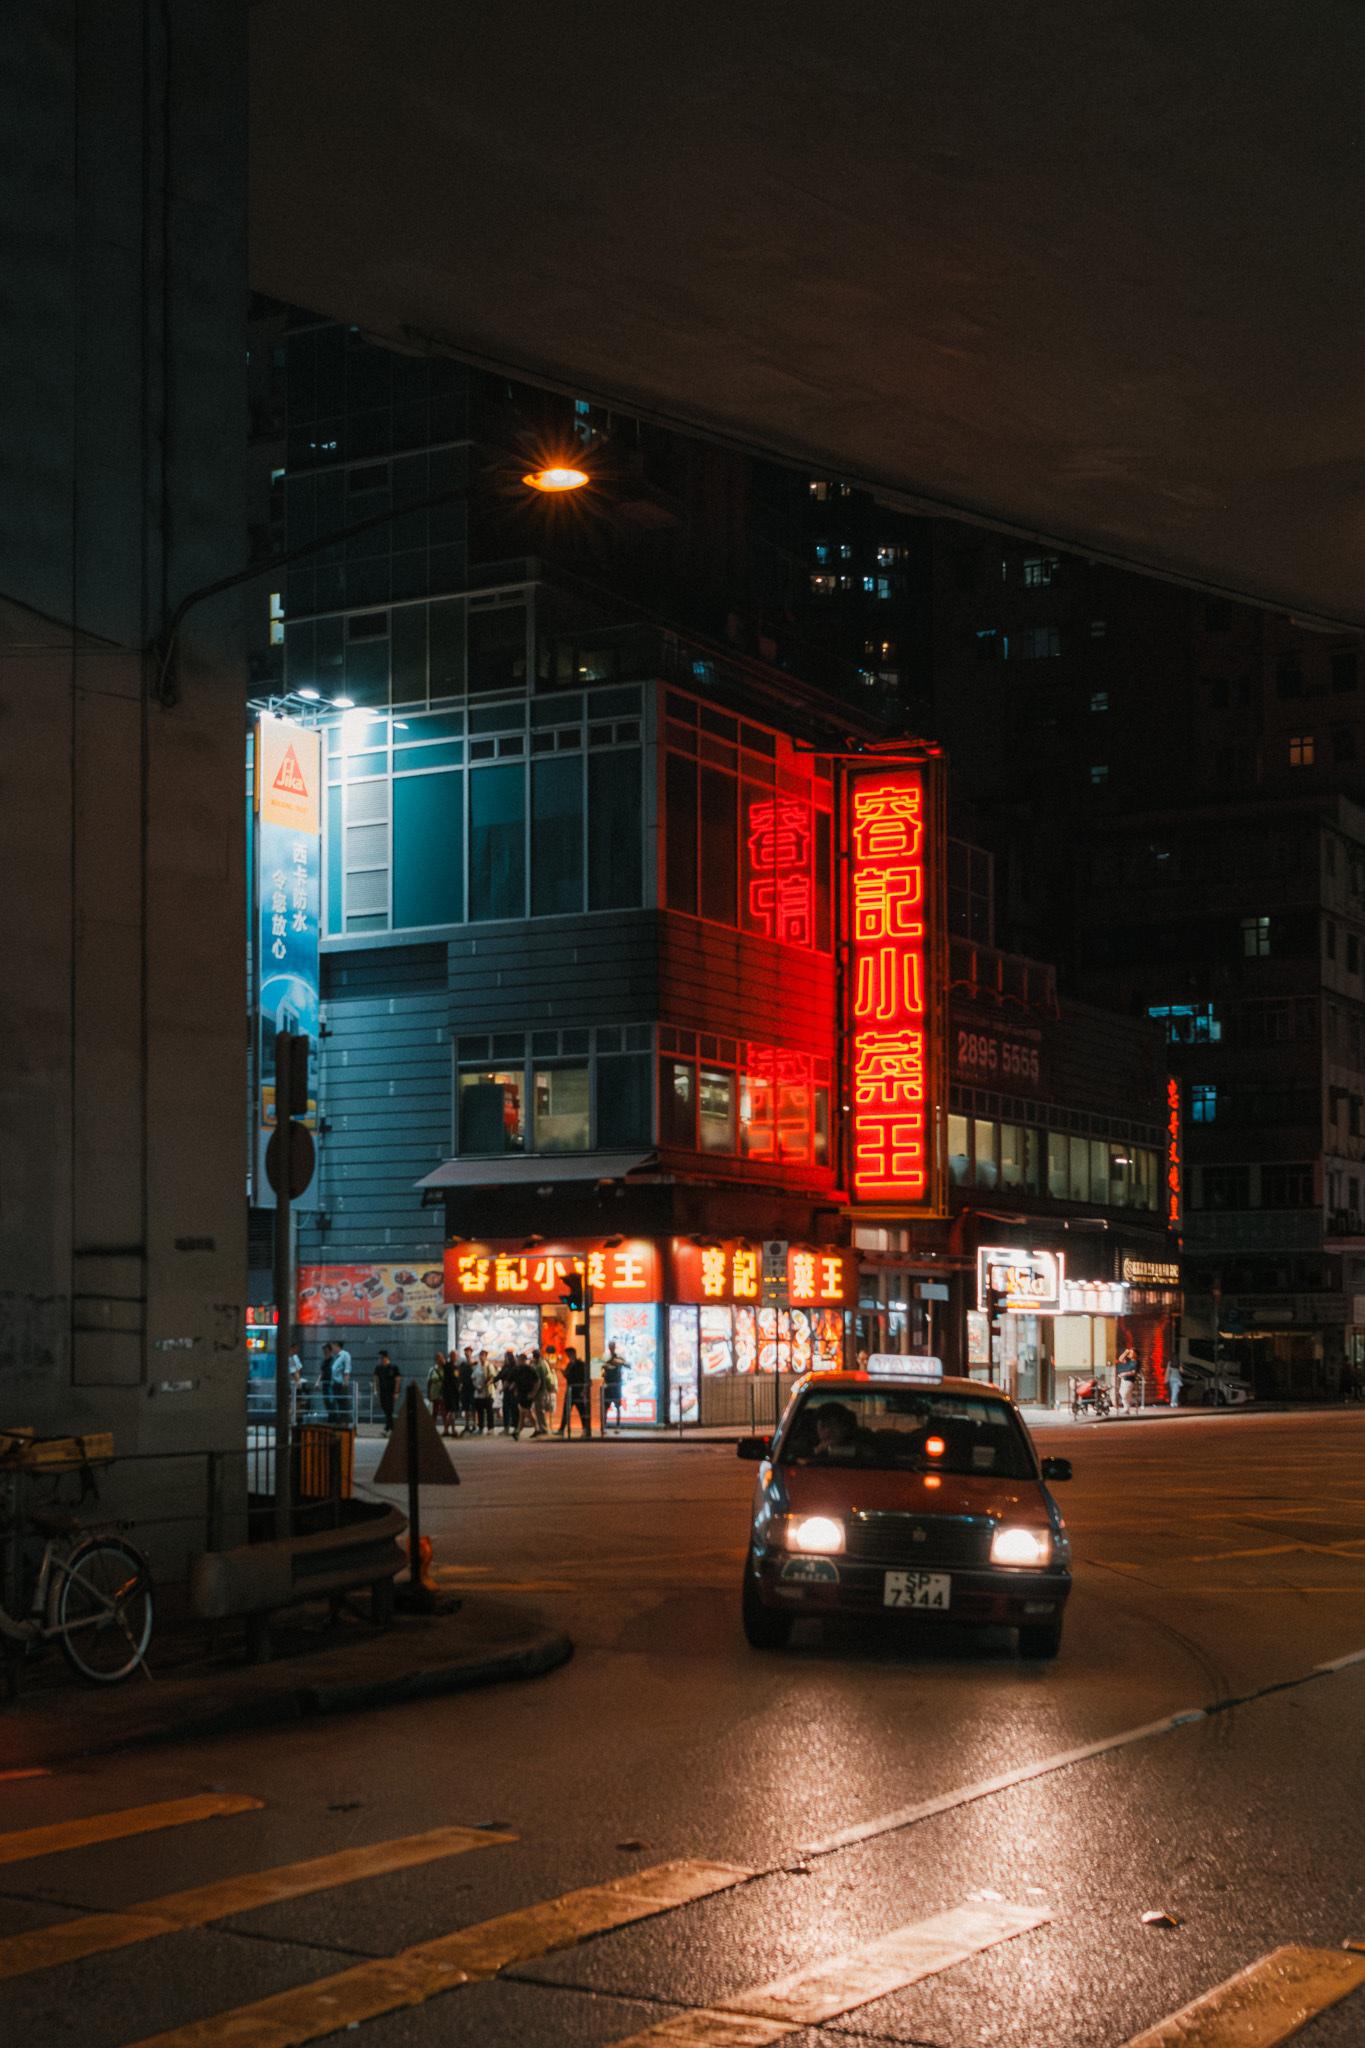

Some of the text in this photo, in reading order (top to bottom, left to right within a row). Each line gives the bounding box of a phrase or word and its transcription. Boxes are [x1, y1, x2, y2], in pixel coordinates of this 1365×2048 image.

[292, 841, 308, 932] 西卡防水
[272, 869, 287, 959] 令您放心
[853, 787, 924, 1187] 容記小菜王
[958, 1030, 998, 1070] 2895
[701, 1248, 844, 1299] 容記菜王
[874, 1357, 937, 1376] TAXI
[890, 1588, 943, 1607] 7344
[905, 1572, 931, 1592] SP
